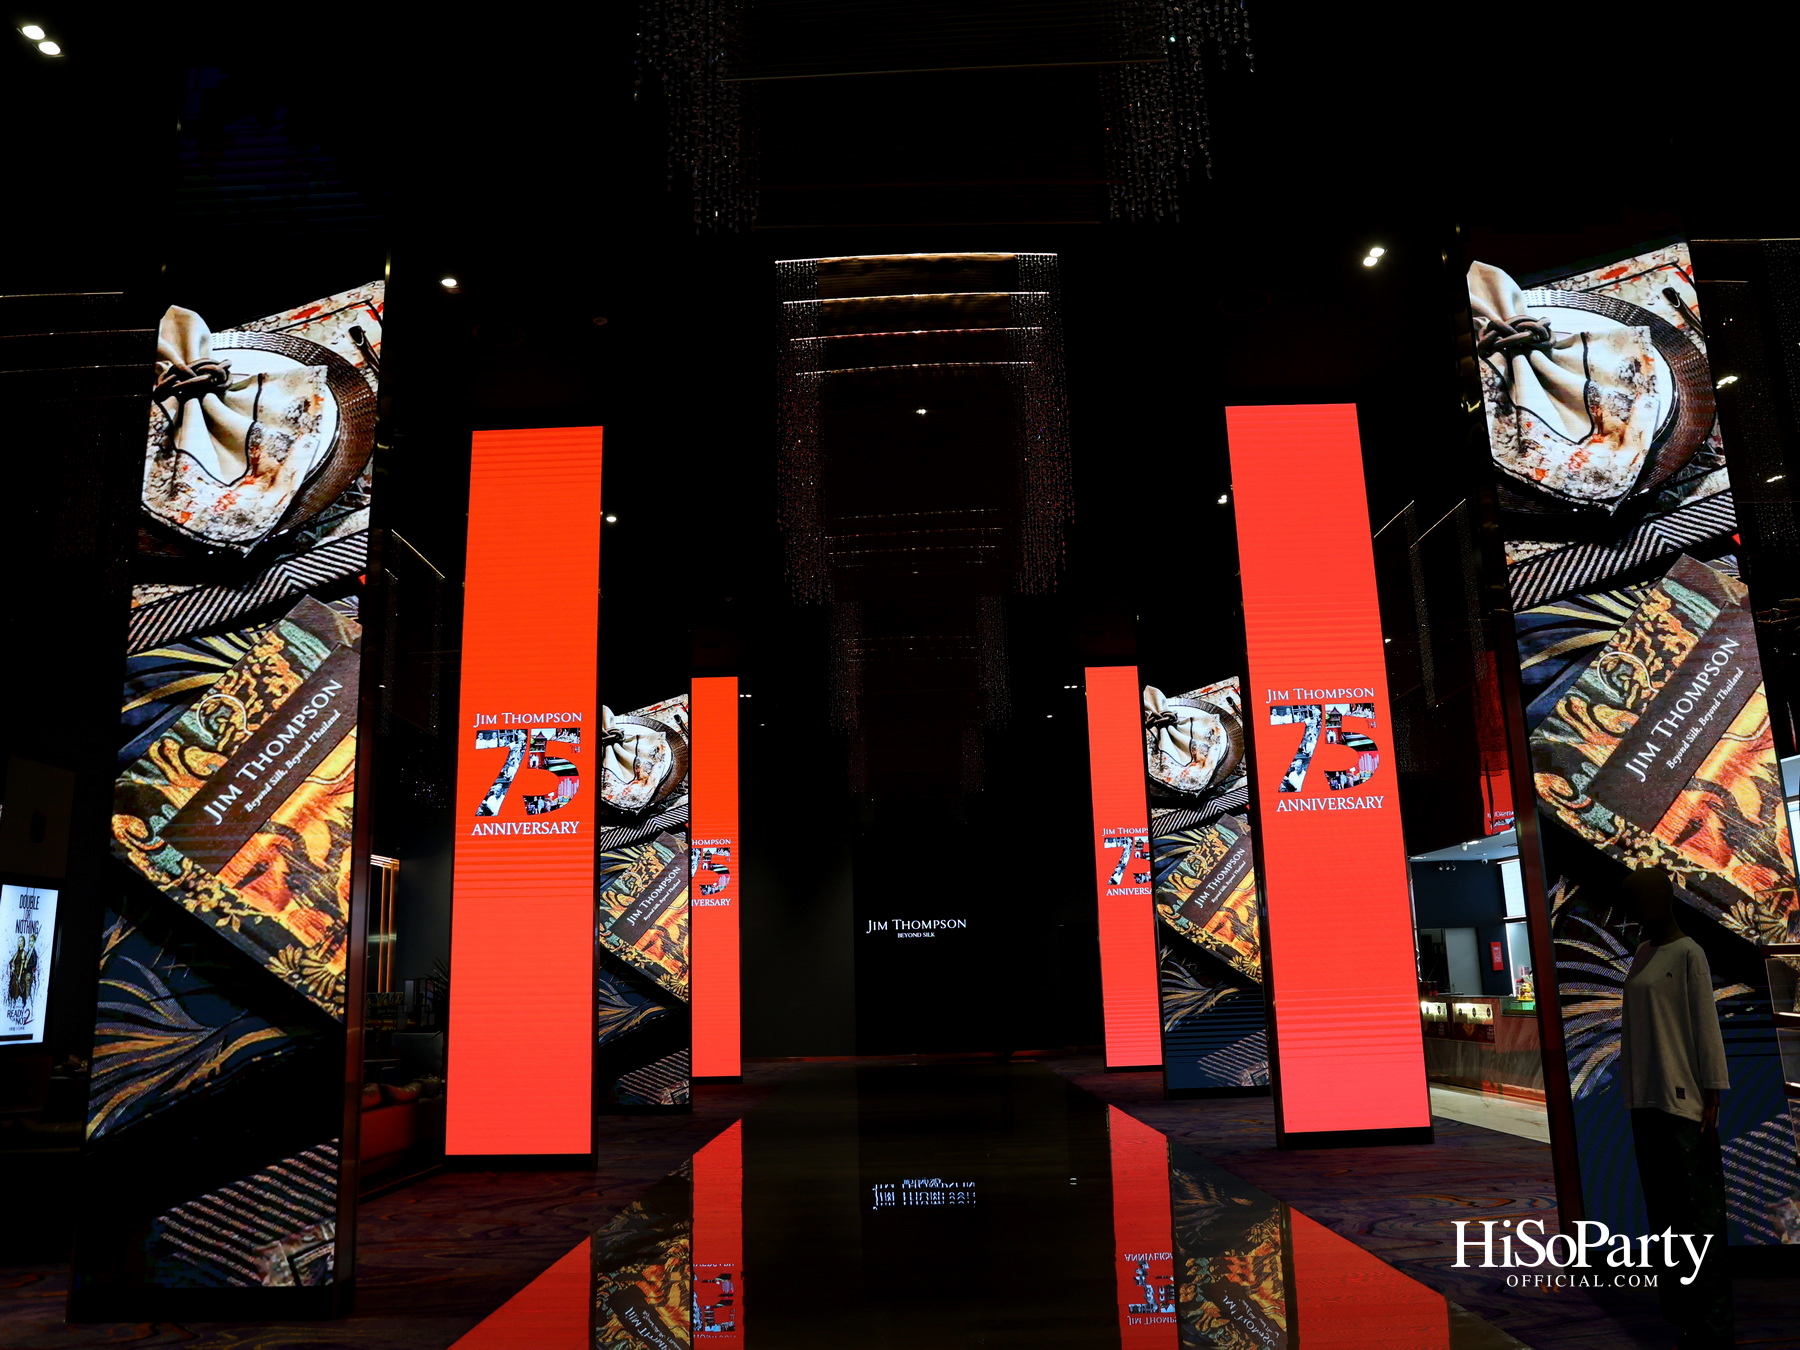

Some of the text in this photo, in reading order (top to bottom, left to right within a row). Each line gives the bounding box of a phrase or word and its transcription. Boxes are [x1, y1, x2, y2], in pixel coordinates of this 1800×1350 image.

[1625, 637, 1740, 783] JIM THOMPSON
[1666, 740, 1690, 769] Beyond
[1698, 698, 1721, 726] Beyond
[1717, 667, 1744, 700] Thailand
[203, 679, 343, 825] JIM THOMPSON
[244, 782, 272, 812] Beyond
[285, 741, 312, 769] Beyond
[308, 709, 342, 743] Thailand
[1276, 796, 1385, 812] ANNIVERSARY
[471, 821, 580, 836] ANNIVERSARY
[1117, 827, 1149, 835] THOMP
[626, 866, 682, 926] JIM THOMPSON
[1194, 848, 1246, 909] JIM THOMPSON
[19, 894, 40, 910] DOUBLE
[691, 899, 731, 907] IVERSARY
[15, 919, 40, 934] NOTHING
